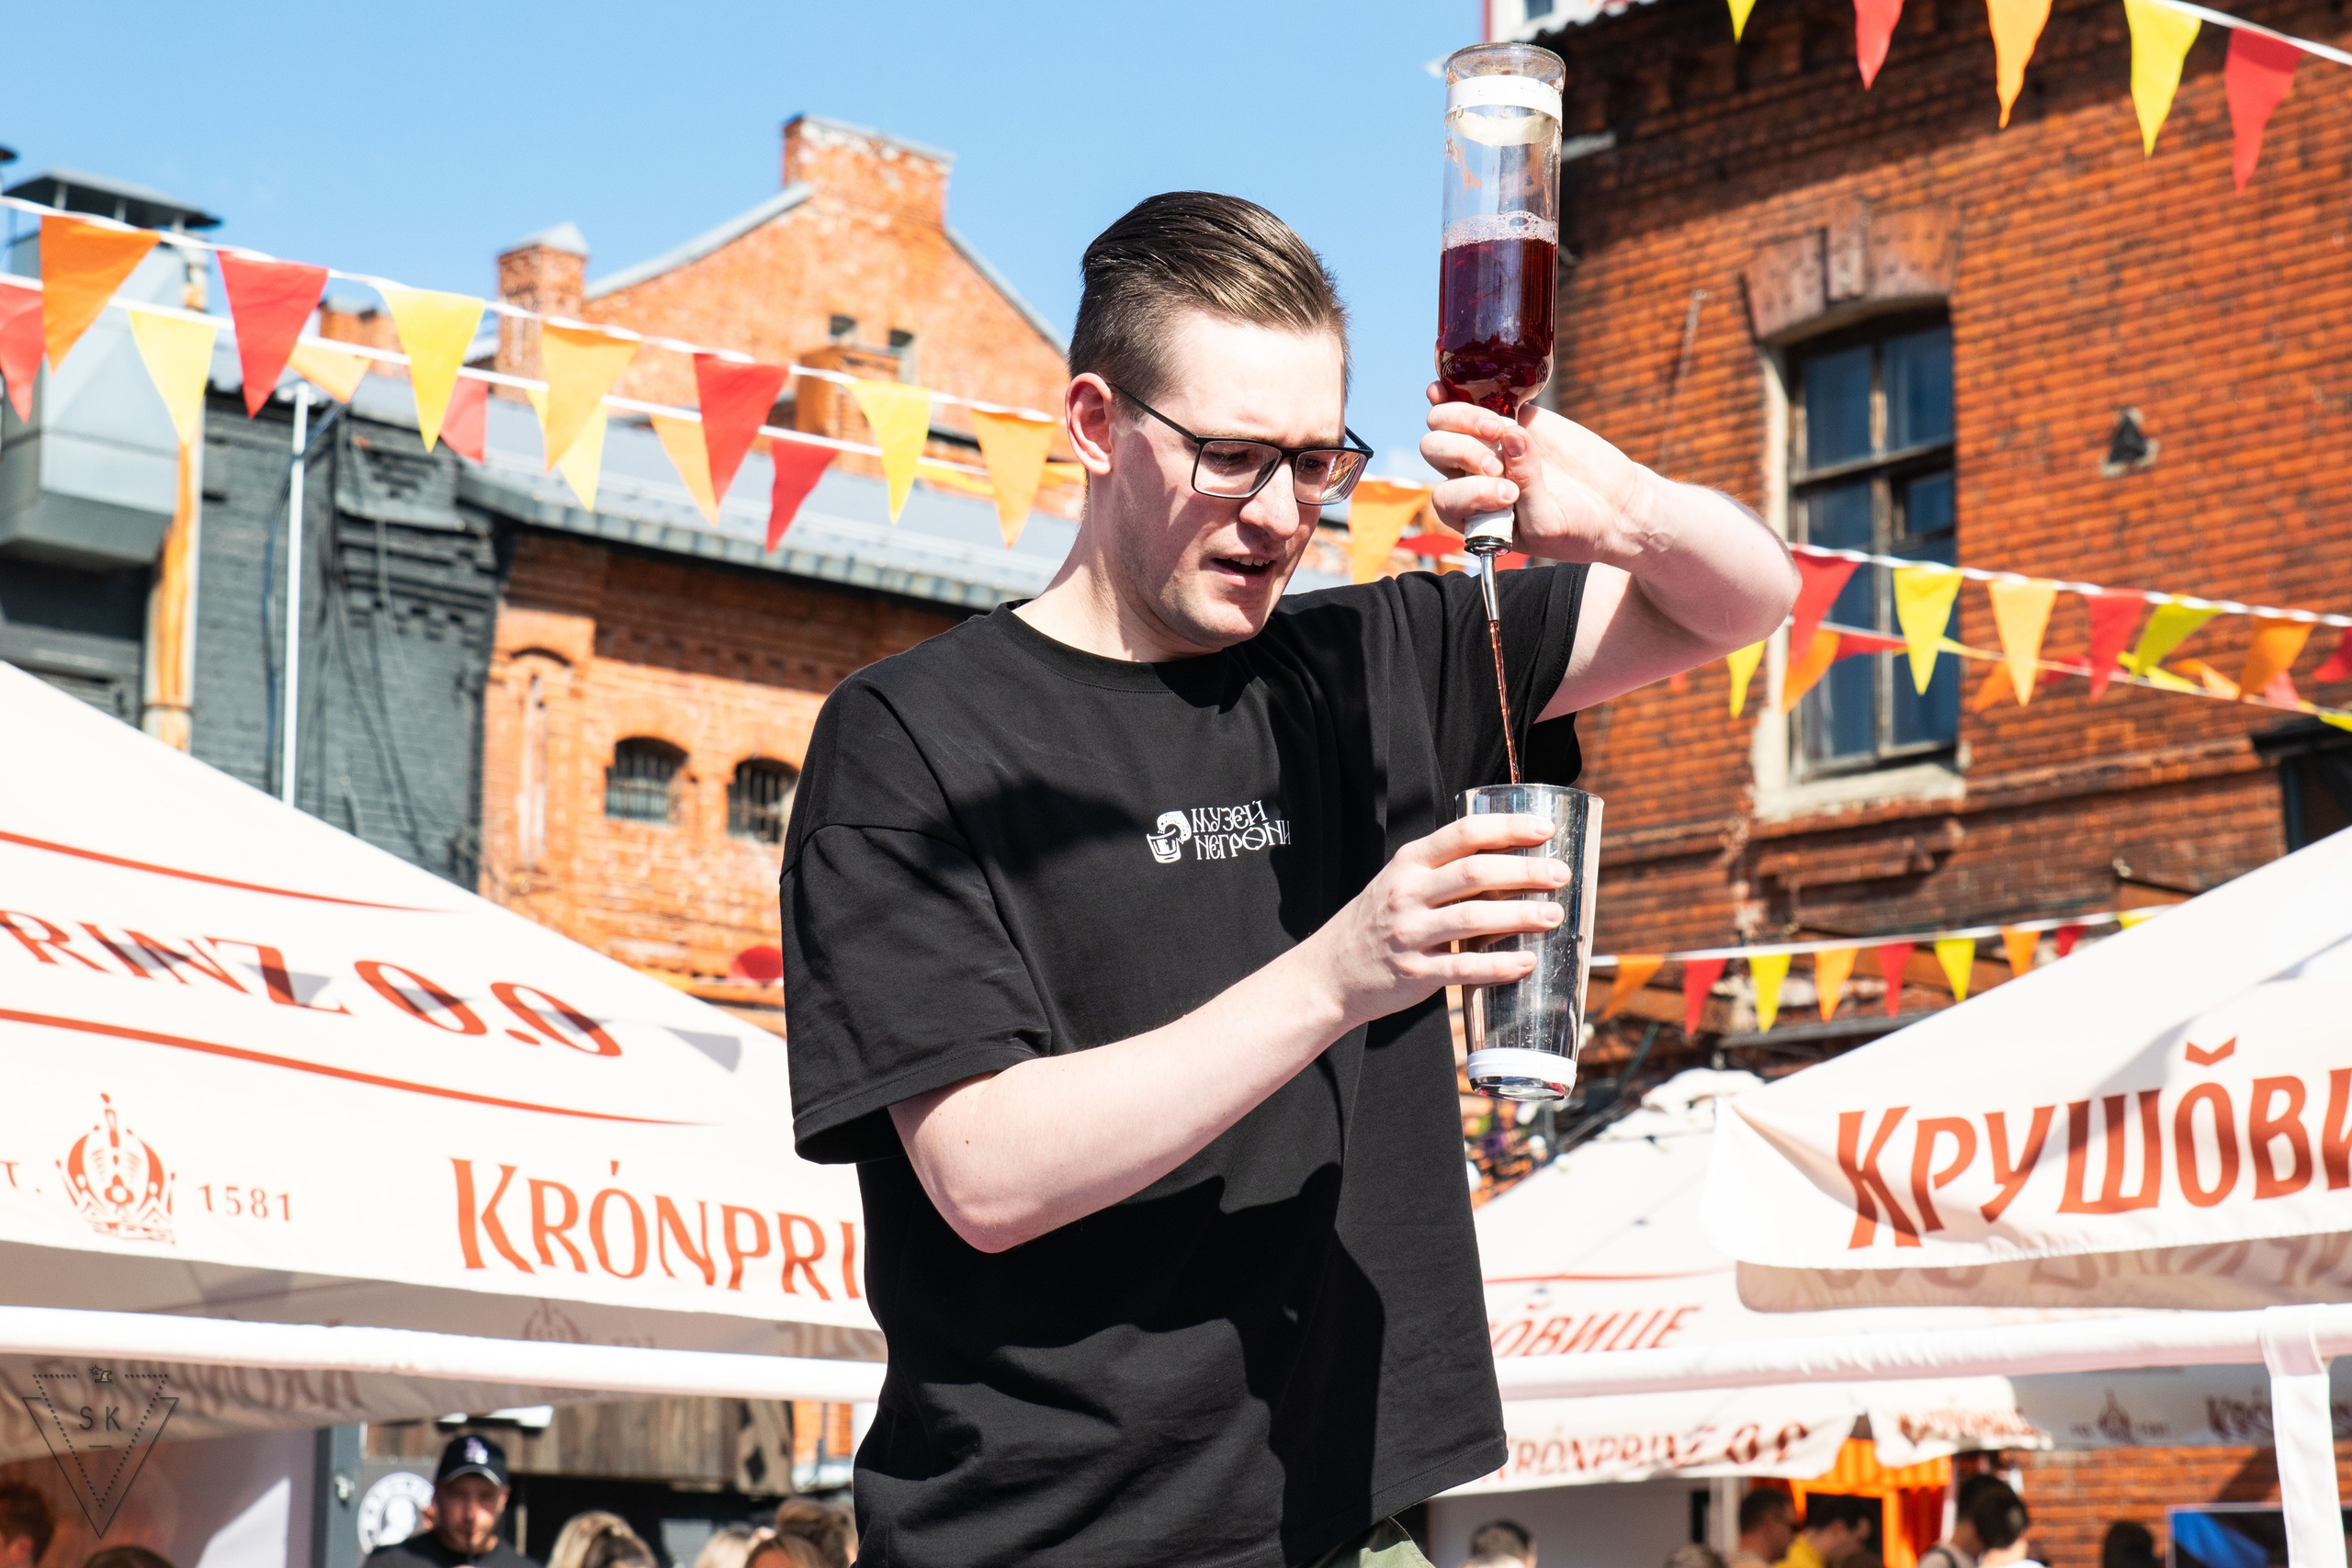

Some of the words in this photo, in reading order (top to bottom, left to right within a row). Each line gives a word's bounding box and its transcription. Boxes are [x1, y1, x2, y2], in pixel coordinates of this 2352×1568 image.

[1191, 800, 1268, 832] МУЗЕЙ
[354, 960, 624, 1057] 0.0
[198, 1184, 290, 1222] 1581
